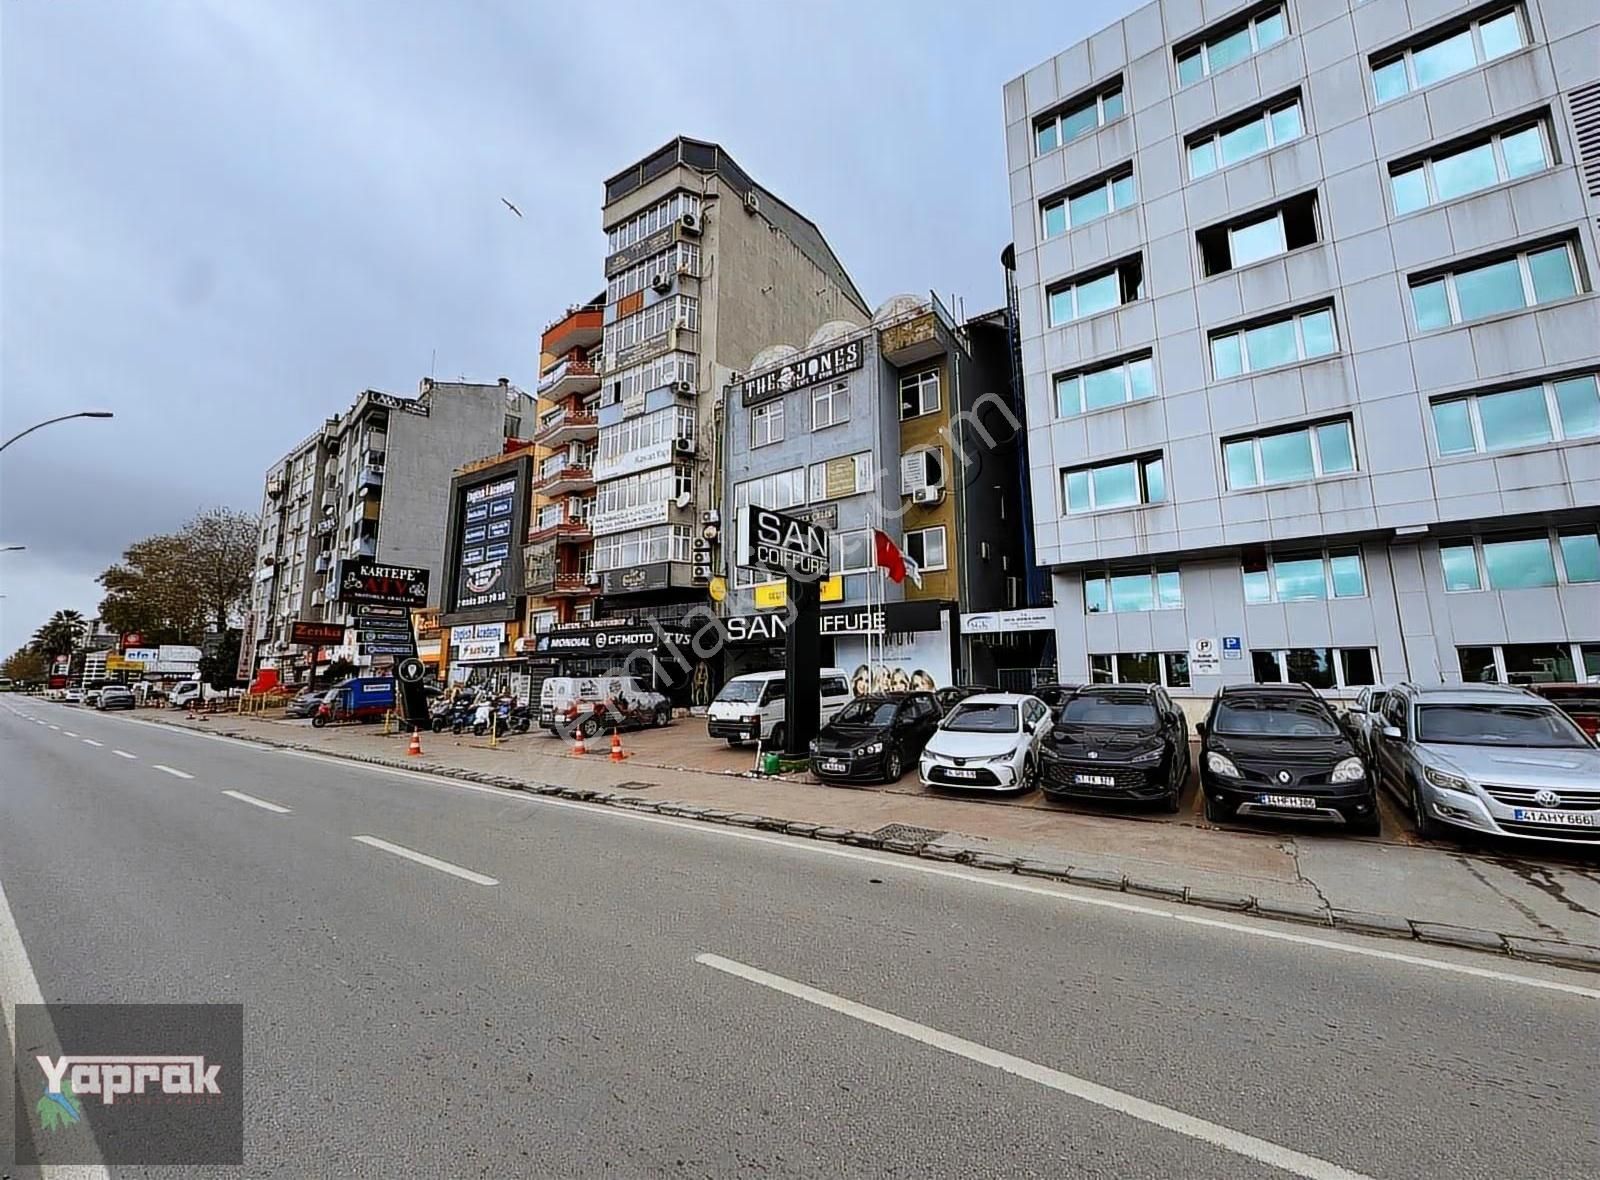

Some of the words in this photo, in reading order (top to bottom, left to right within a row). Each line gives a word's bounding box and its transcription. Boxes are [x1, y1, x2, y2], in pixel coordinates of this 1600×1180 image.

[745, 372, 776, 398] THE
[797, 343, 857, 380] JONES
[757, 512, 828, 557] SAN
[360, 565, 416, 581] KARTEPE
[757, 546, 829, 575] COIFFURE
[664, 632, 692, 645] TVS
[727, 614, 787, 640] SAN
[820, 612, 886, 632] IFFURE
[550, 637, 592, 648] MONDIAL
[608, 633, 654, 645] CFMOTO
